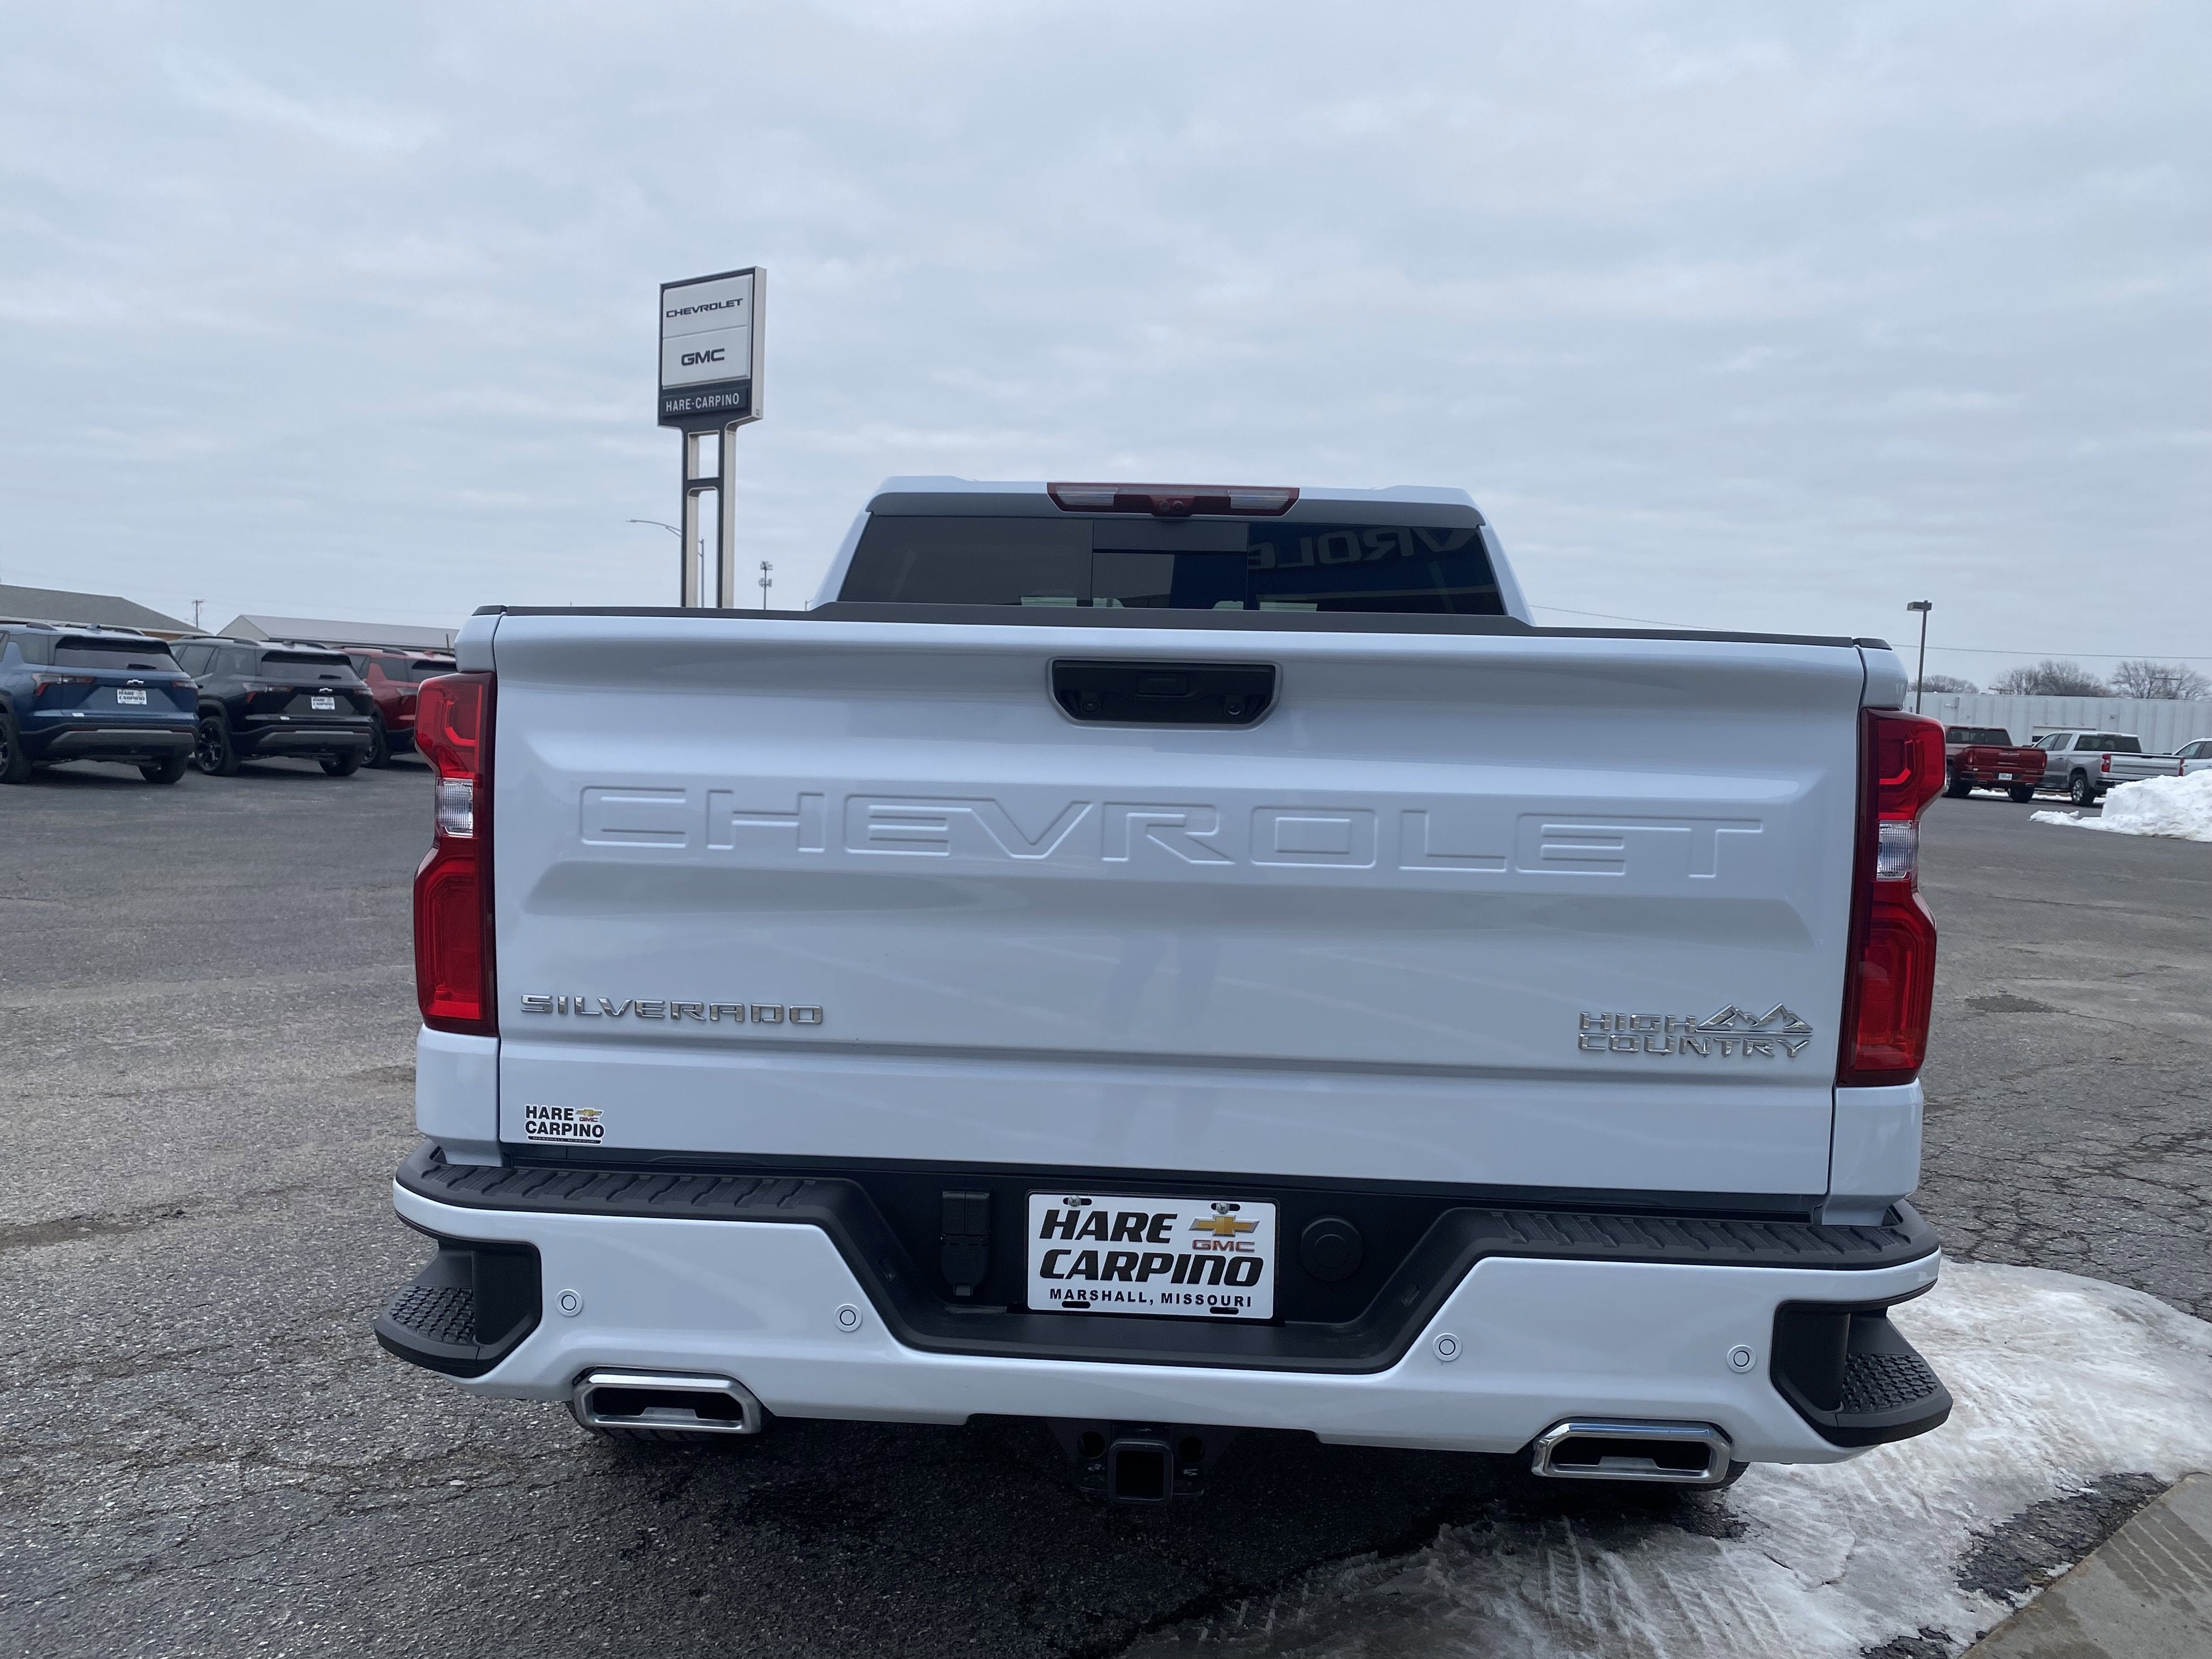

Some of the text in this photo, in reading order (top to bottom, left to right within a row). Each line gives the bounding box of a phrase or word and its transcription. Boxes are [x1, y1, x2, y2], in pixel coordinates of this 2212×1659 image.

[666, 298, 743, 318] CHEVROLET
[681, 348, 725, 366] GMC
[666, 393, 740, 412] HARE-CARPINO
[580, 786, 1763, 877] CHEVROLET
[521, 994, 823, 1025] SILVERADO
[1580, 1012, 1696, 1034] HIGH
[1578, 1033, 1810, 1057] COUNTRY
[526, 1105, 574, 1121] HARE
[525, 1121, 604, 1138] CARPINO
[1039, 1209, 1177, 1243] HARE
[1192, 1239, 1255, 1252] GMC
[1039, 1249, 1263, 1286] CARPINO
[1049, 1289, 1251, 1307] MARSHALL, MISSOURI
